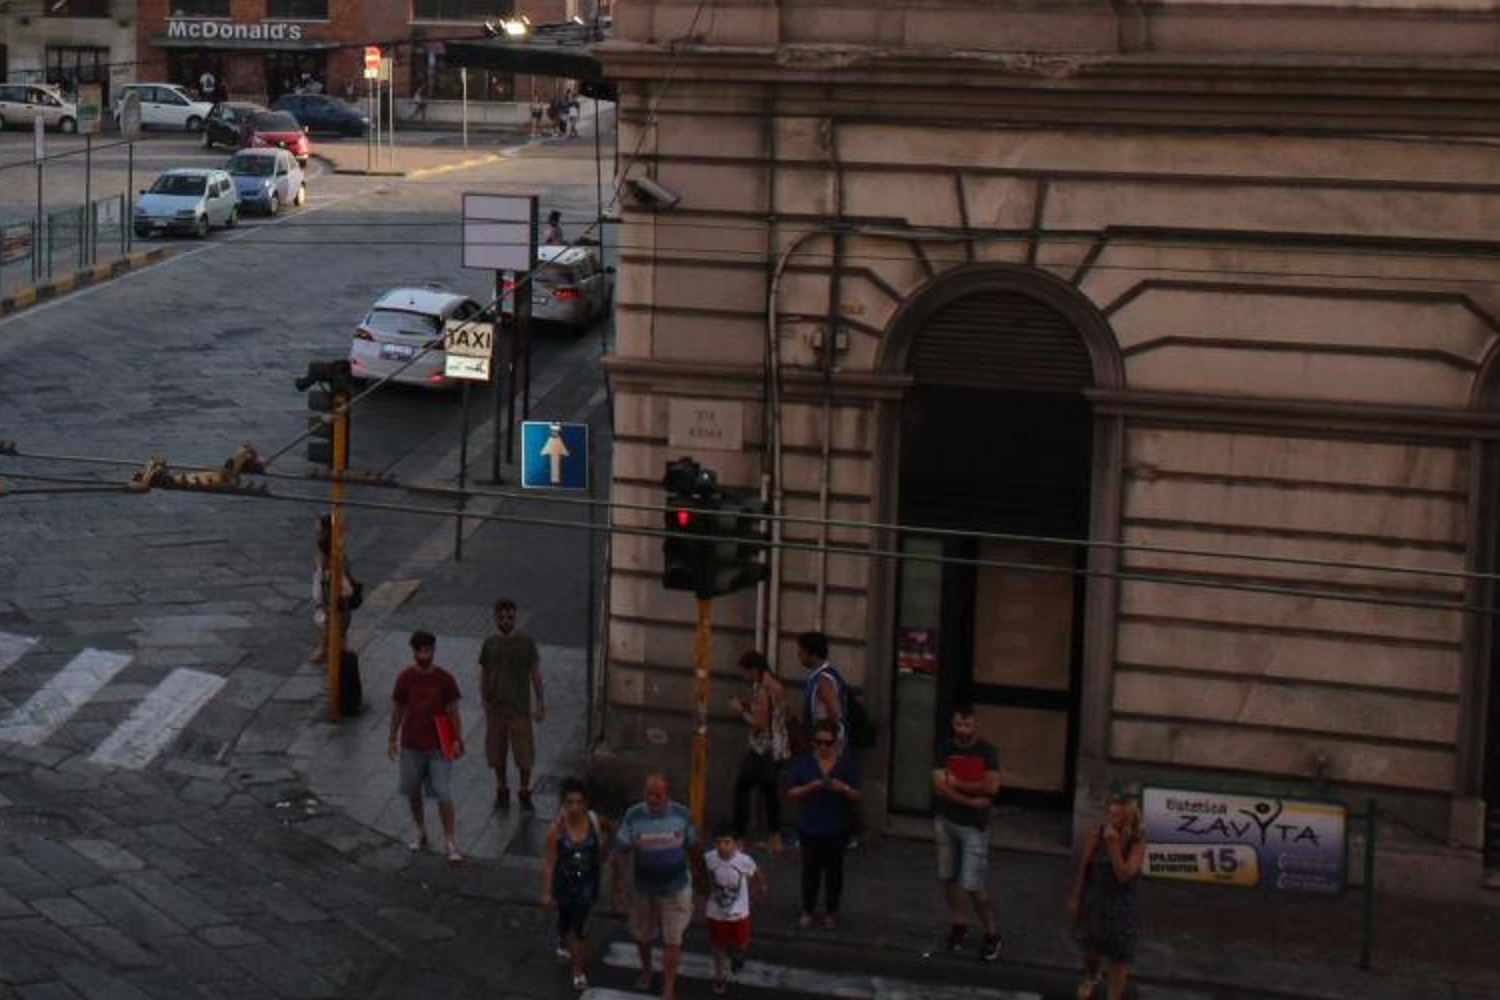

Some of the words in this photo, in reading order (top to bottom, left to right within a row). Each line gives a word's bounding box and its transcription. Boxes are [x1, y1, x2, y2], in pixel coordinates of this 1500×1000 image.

[168, 21, 302, 40] McDonald's
[447, 327, 491, 349] TAXI
[1201, 847, 1238, 873] 15
